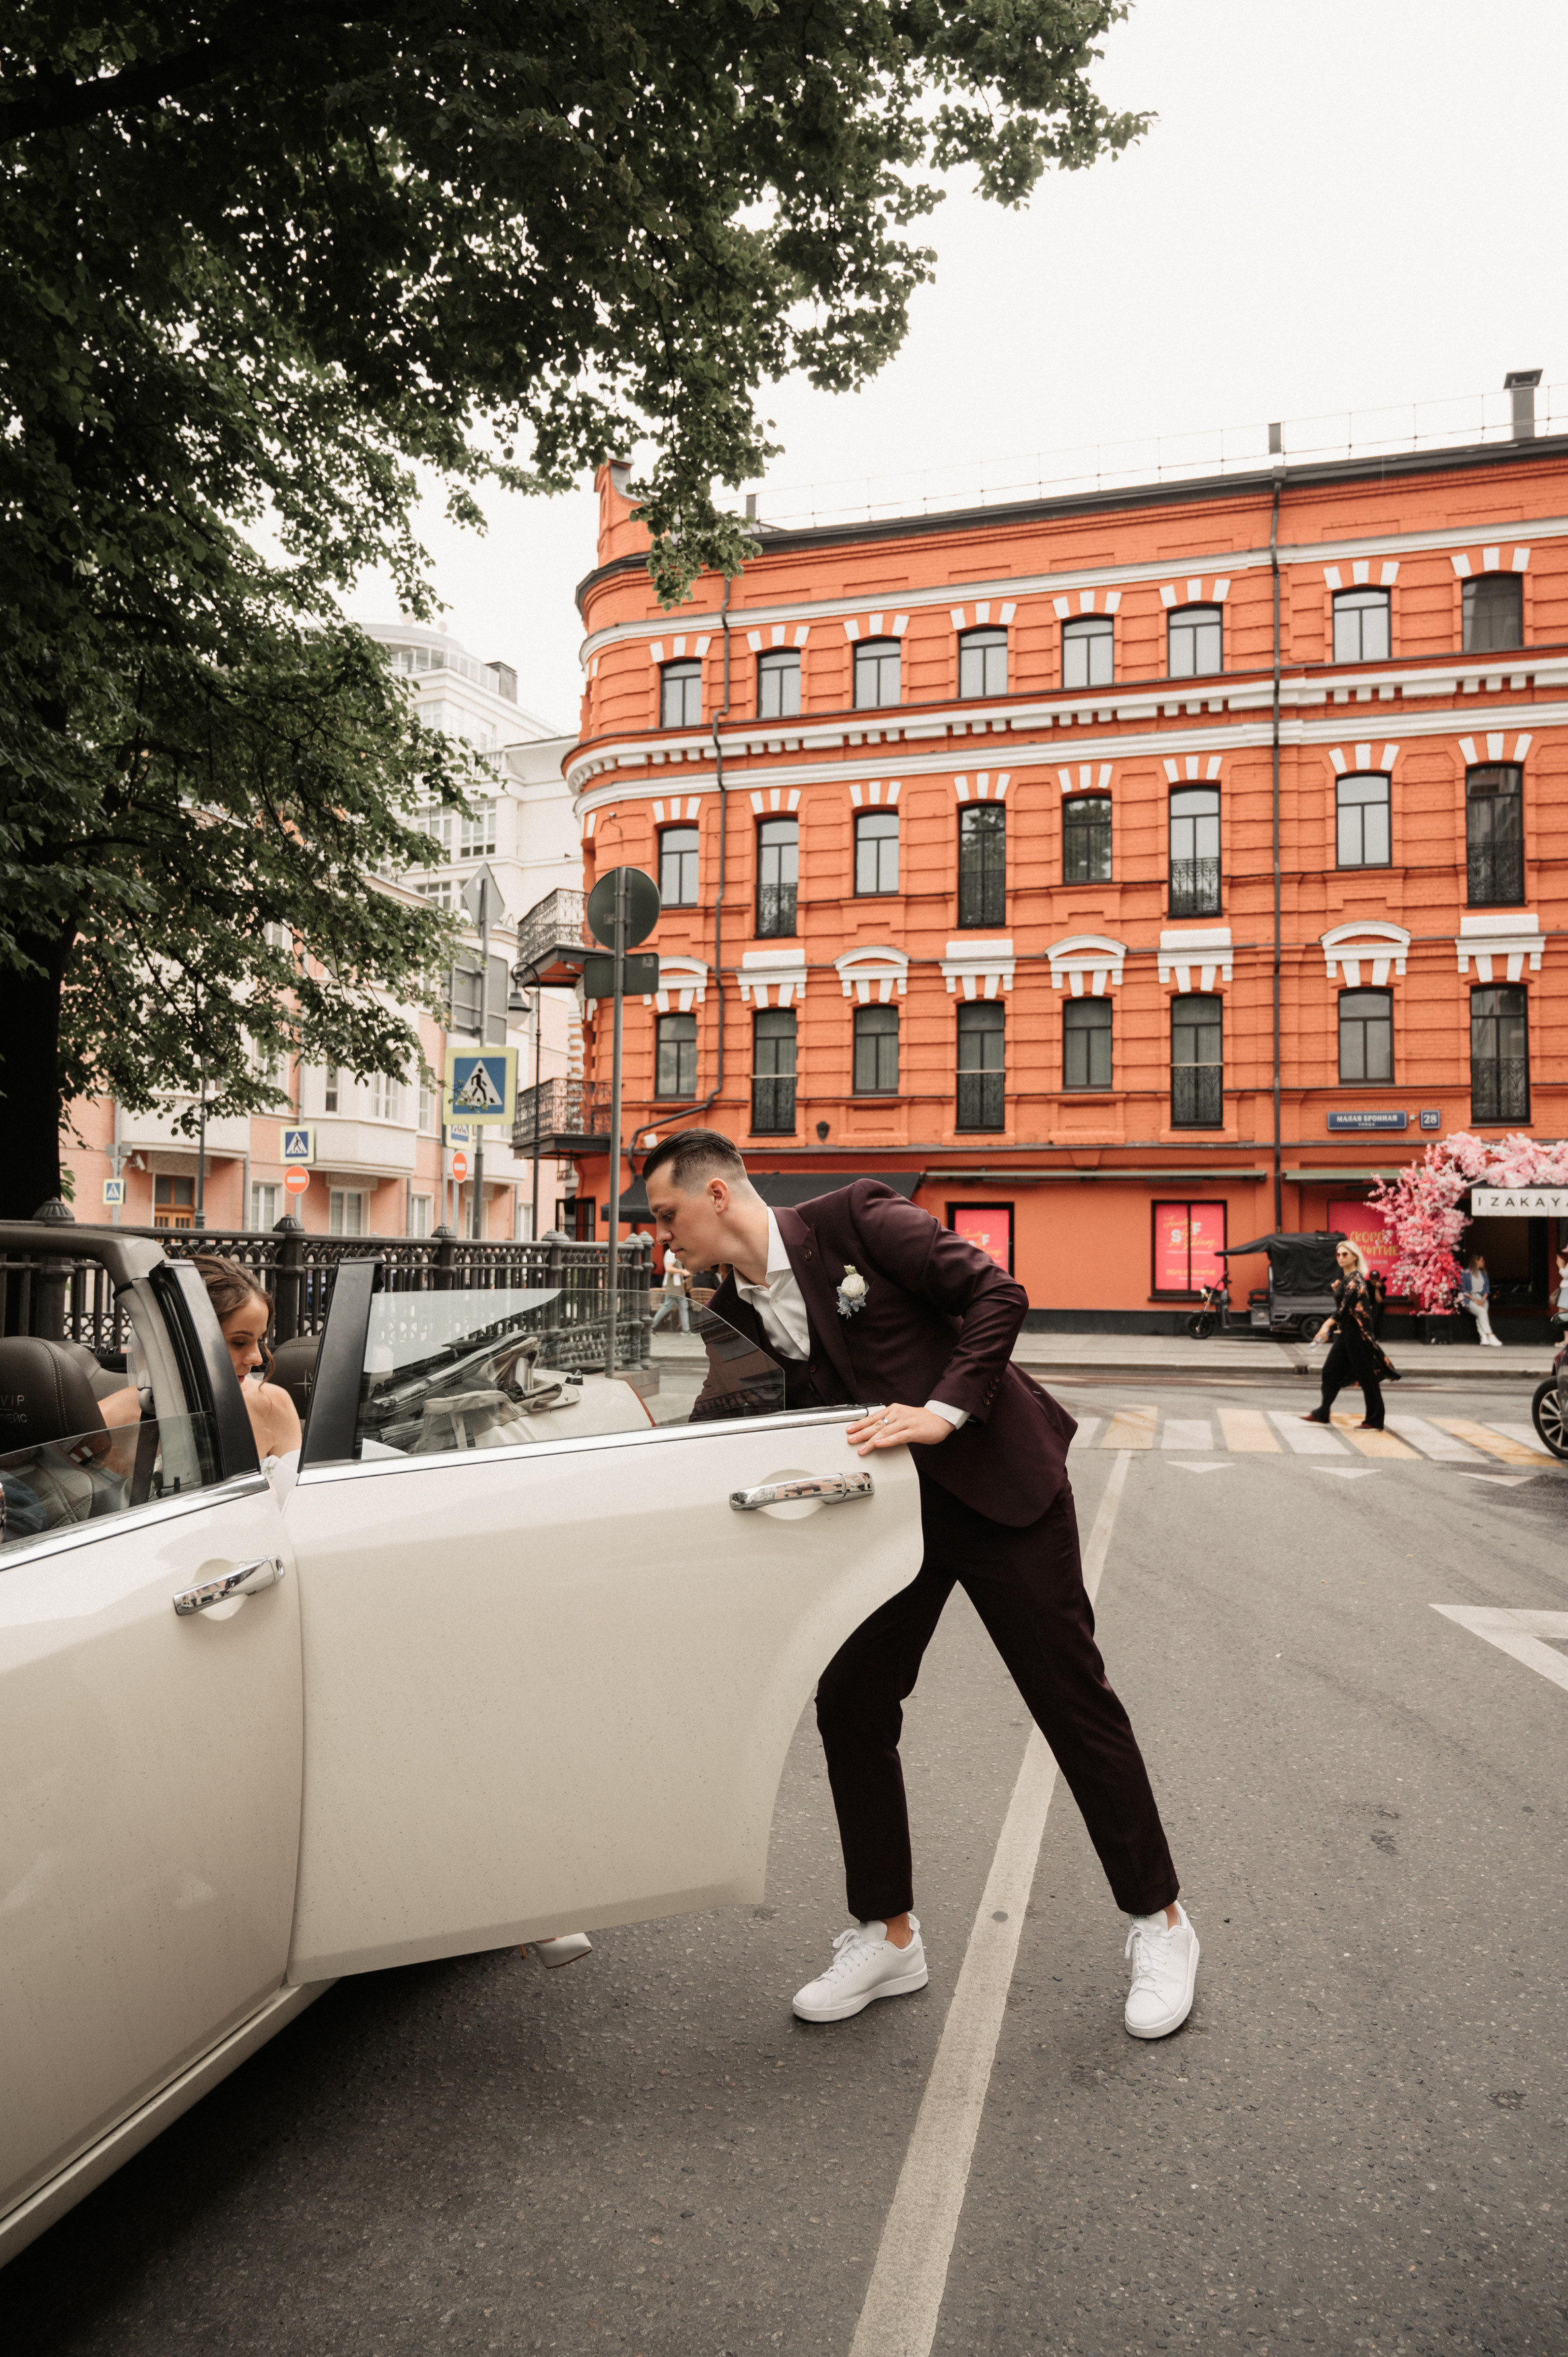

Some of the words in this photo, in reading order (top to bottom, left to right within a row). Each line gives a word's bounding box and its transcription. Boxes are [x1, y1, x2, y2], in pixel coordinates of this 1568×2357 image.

[1336, 1115, 1362, 1123] МАЛАЯ
[1363, 1114, 1398, 1122] БРОННАЯ
[1423, 1114, 1437, 1124] 28
[1478, 1197, 1568, 1207] IZAKAY
[1, 1395, 25, 1406] VIP
